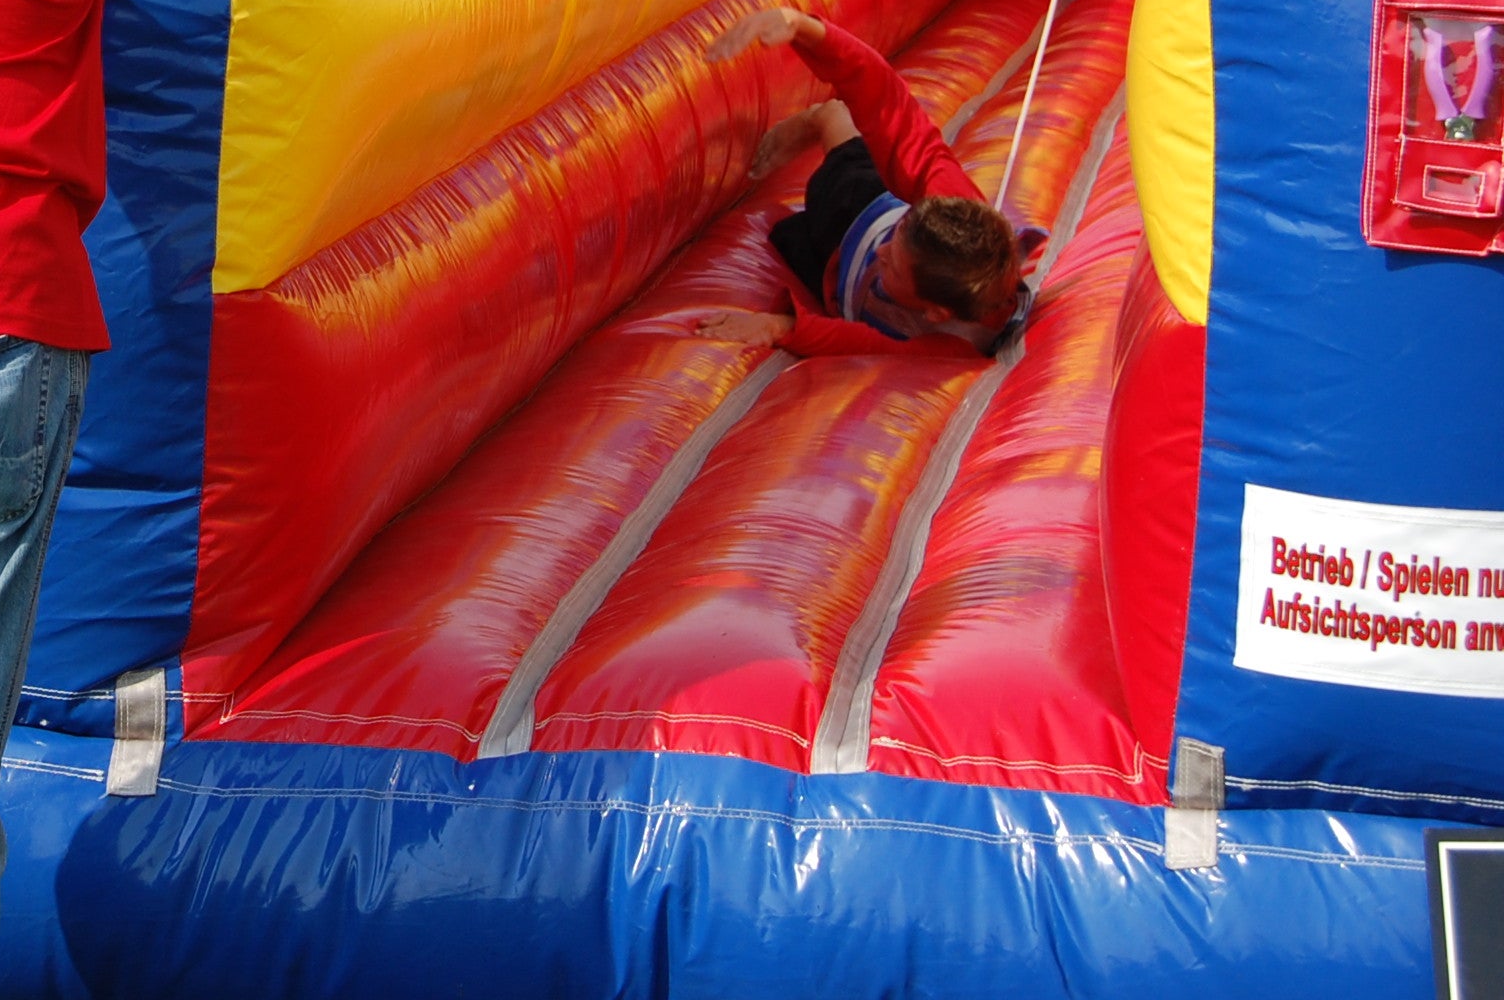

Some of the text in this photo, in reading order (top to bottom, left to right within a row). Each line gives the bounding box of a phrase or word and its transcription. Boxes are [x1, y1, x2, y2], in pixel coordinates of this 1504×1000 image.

[1271, 536, 1354, 587] Betrieb
[1377, 551, 1469, 602] Spielen
[1259, 587, 1456, 651] Aufsichtsperson
